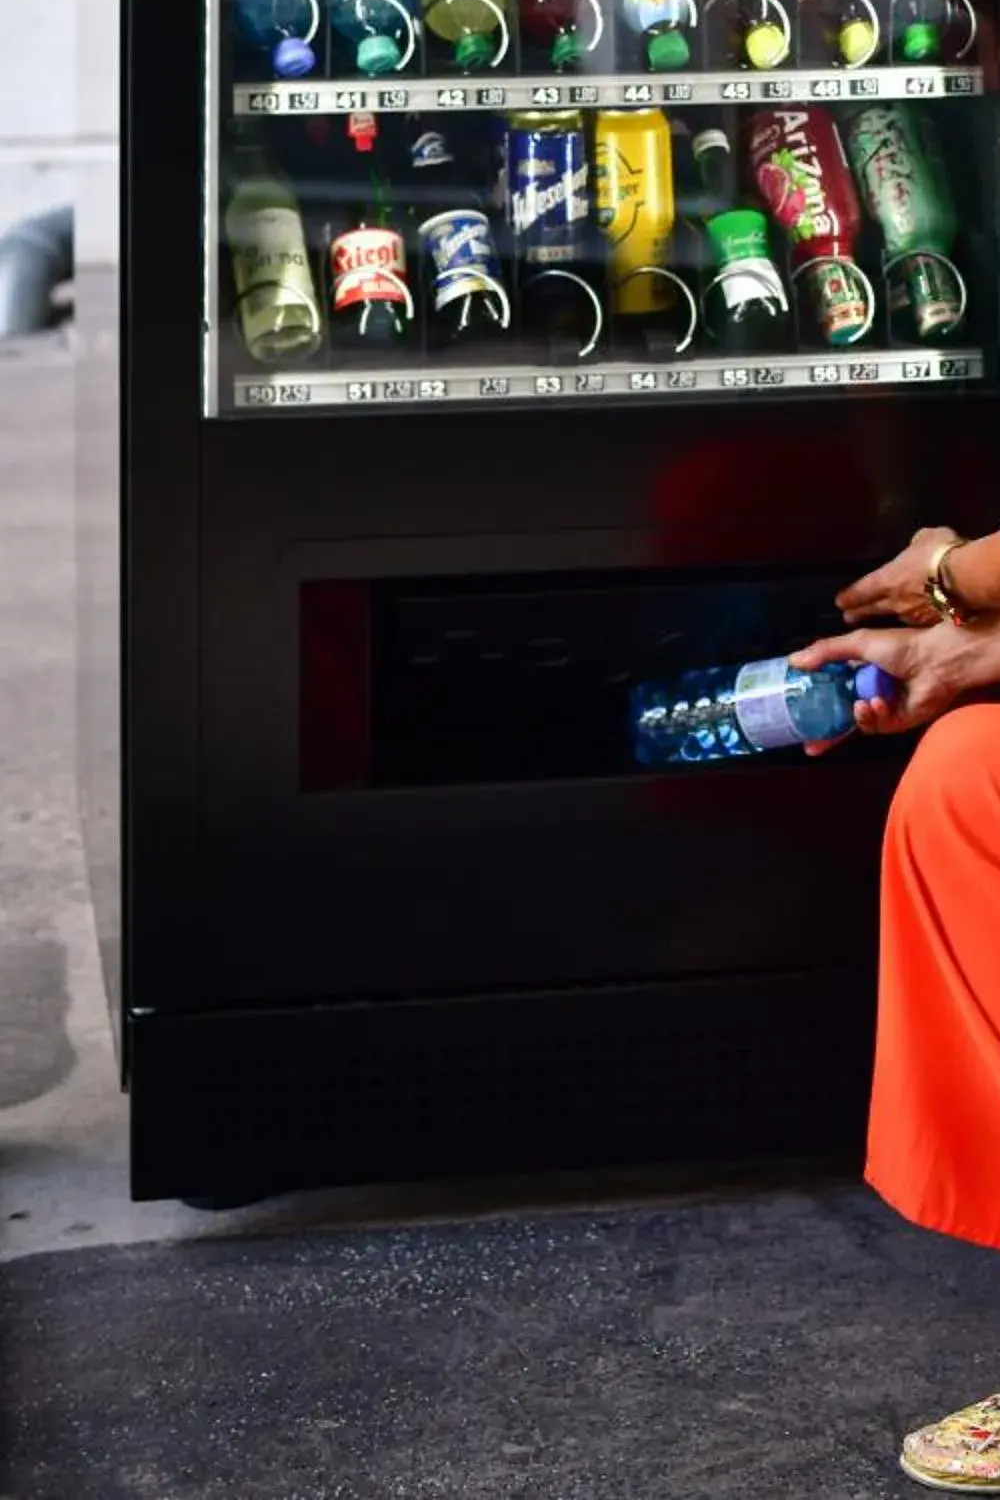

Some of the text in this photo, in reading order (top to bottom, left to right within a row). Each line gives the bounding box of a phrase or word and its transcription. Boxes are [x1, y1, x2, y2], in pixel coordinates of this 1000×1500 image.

[251, 94, 279, 109] 40
[337, 92, 363, 108] 41
[438, 90, 465, 106] 42
[533, 88, 560, 104] 43
[624, 86, 652, 102] 44
[722, 83, 750, 99] 45
[906, 78, 934, 93] 47
[247, 387, 275, 402] 50
[348, 383, 374, 398] 51
[420, 380, 446, 395] 52
[535, 377, 561, 392] 53
[630, 373, 656, 389] 54
[722, 370, 748, 385] 55
[812, 367, 839, 381] 56
[903, 362, 929, 378] 57
